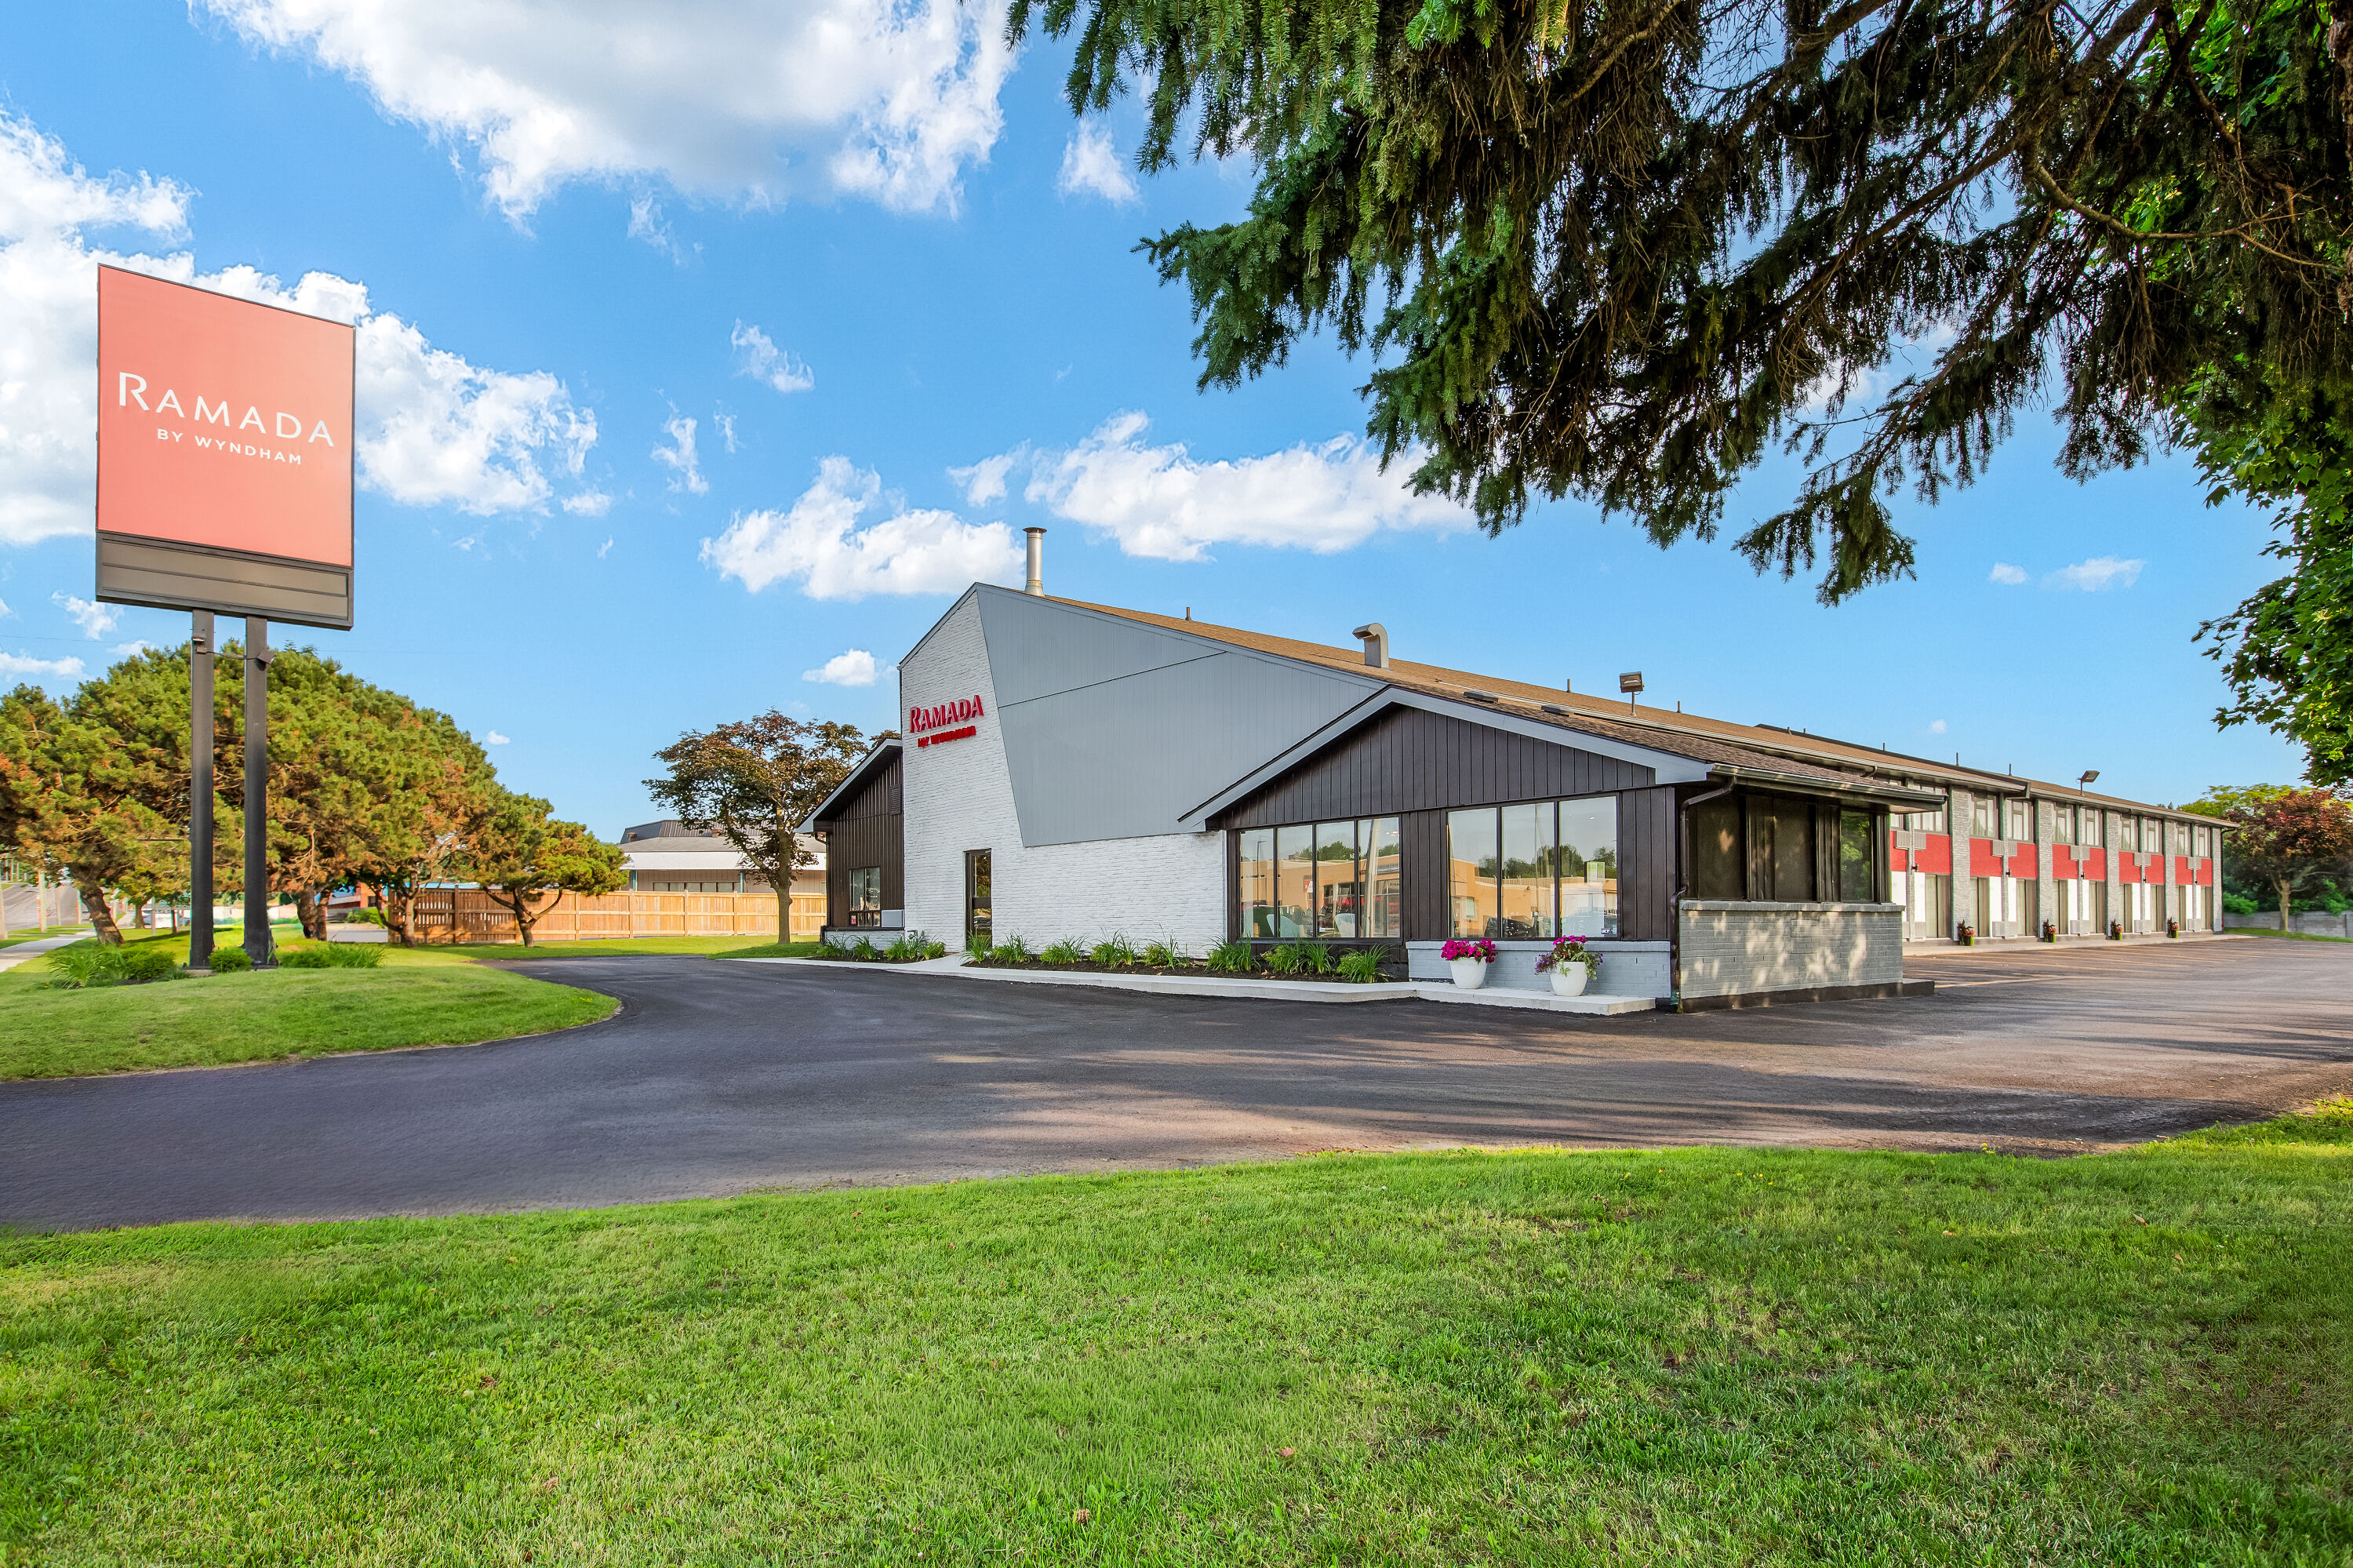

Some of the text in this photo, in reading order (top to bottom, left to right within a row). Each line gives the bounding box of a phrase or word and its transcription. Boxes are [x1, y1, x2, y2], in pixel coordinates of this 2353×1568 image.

[119, 372, 334, 447] RAMADA
[158, 428, 301, 465] BY WYNDHAM
[910, 695, 984, 733] RAMADA
